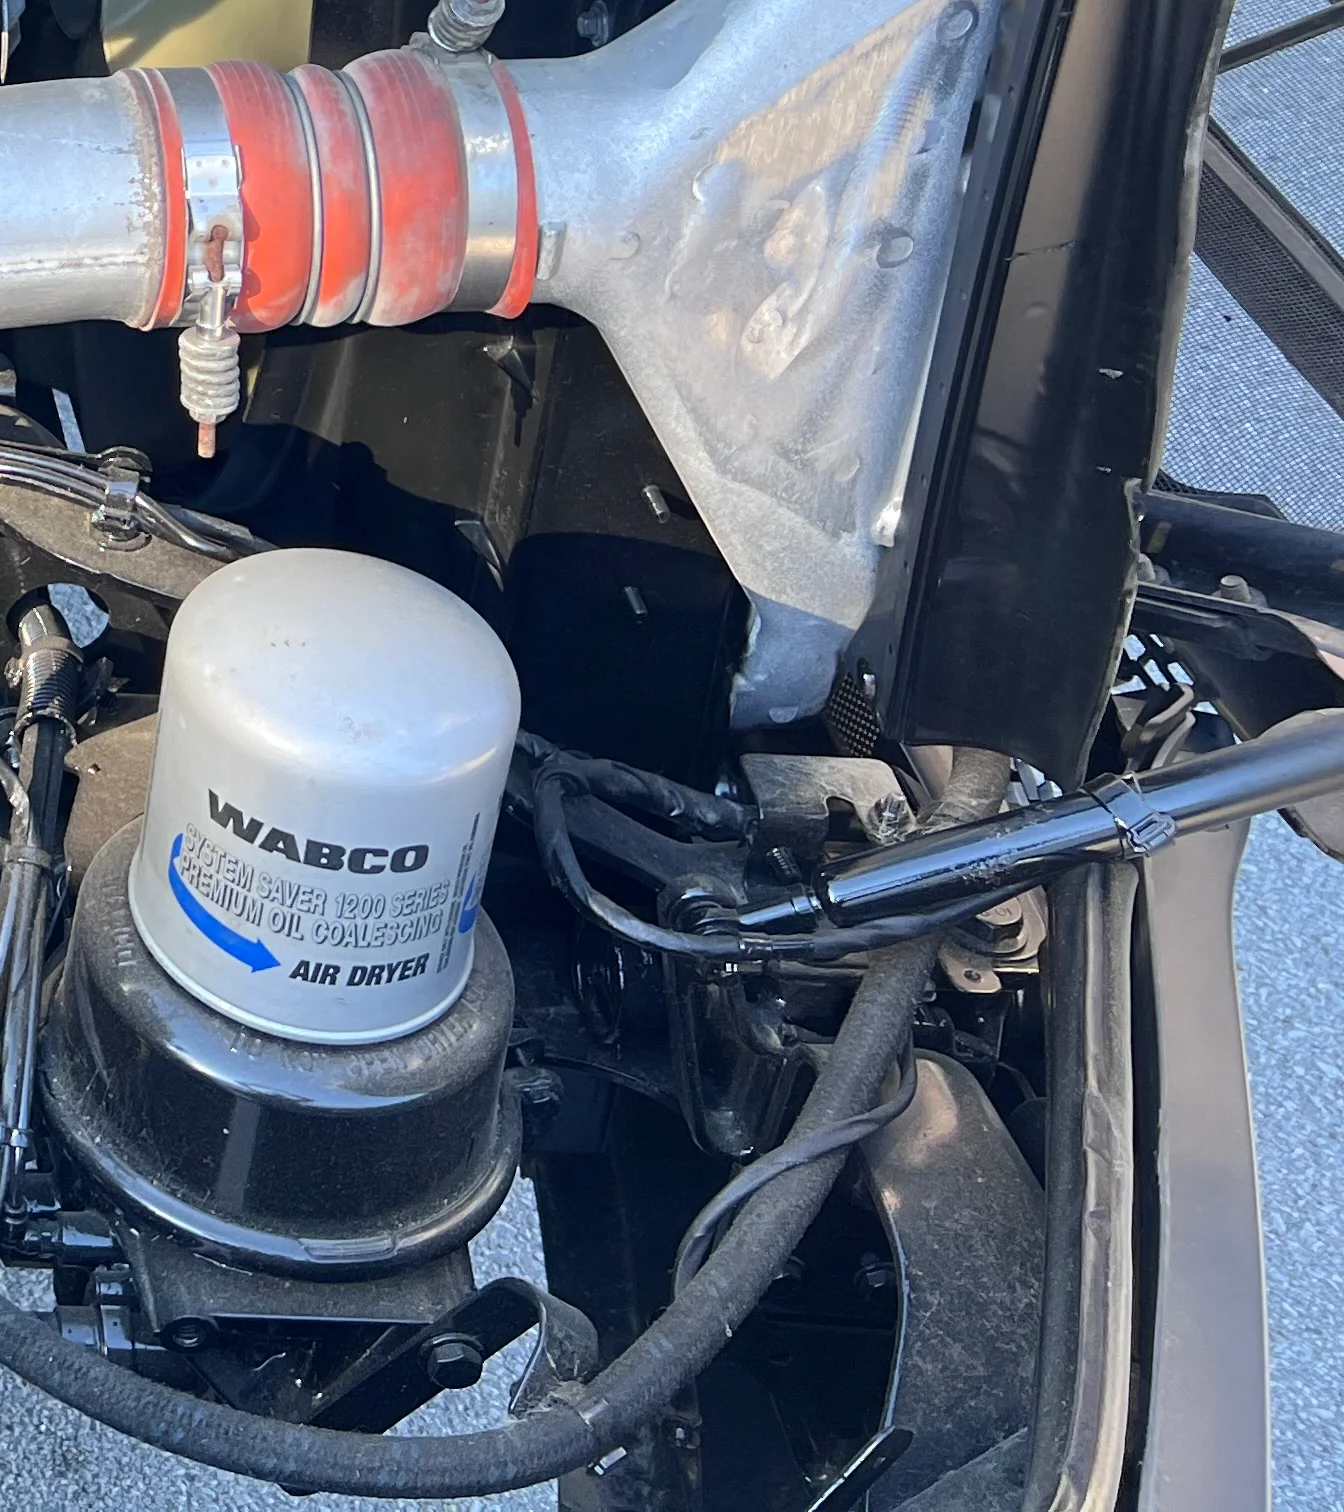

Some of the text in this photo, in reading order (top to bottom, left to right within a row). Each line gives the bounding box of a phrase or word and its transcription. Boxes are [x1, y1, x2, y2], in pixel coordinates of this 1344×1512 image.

[185, 821, 451, 920] SYSTEM SAVER 1200 SERIES
[207, 787, 430, 875] WABCO
[180, 851, 264, 928] PREMIUM
[268, 905, 305, 941] OIL
[312, 908, 444, 948] COALESCING
[288, 952, 431, 987] AIR DRYER
